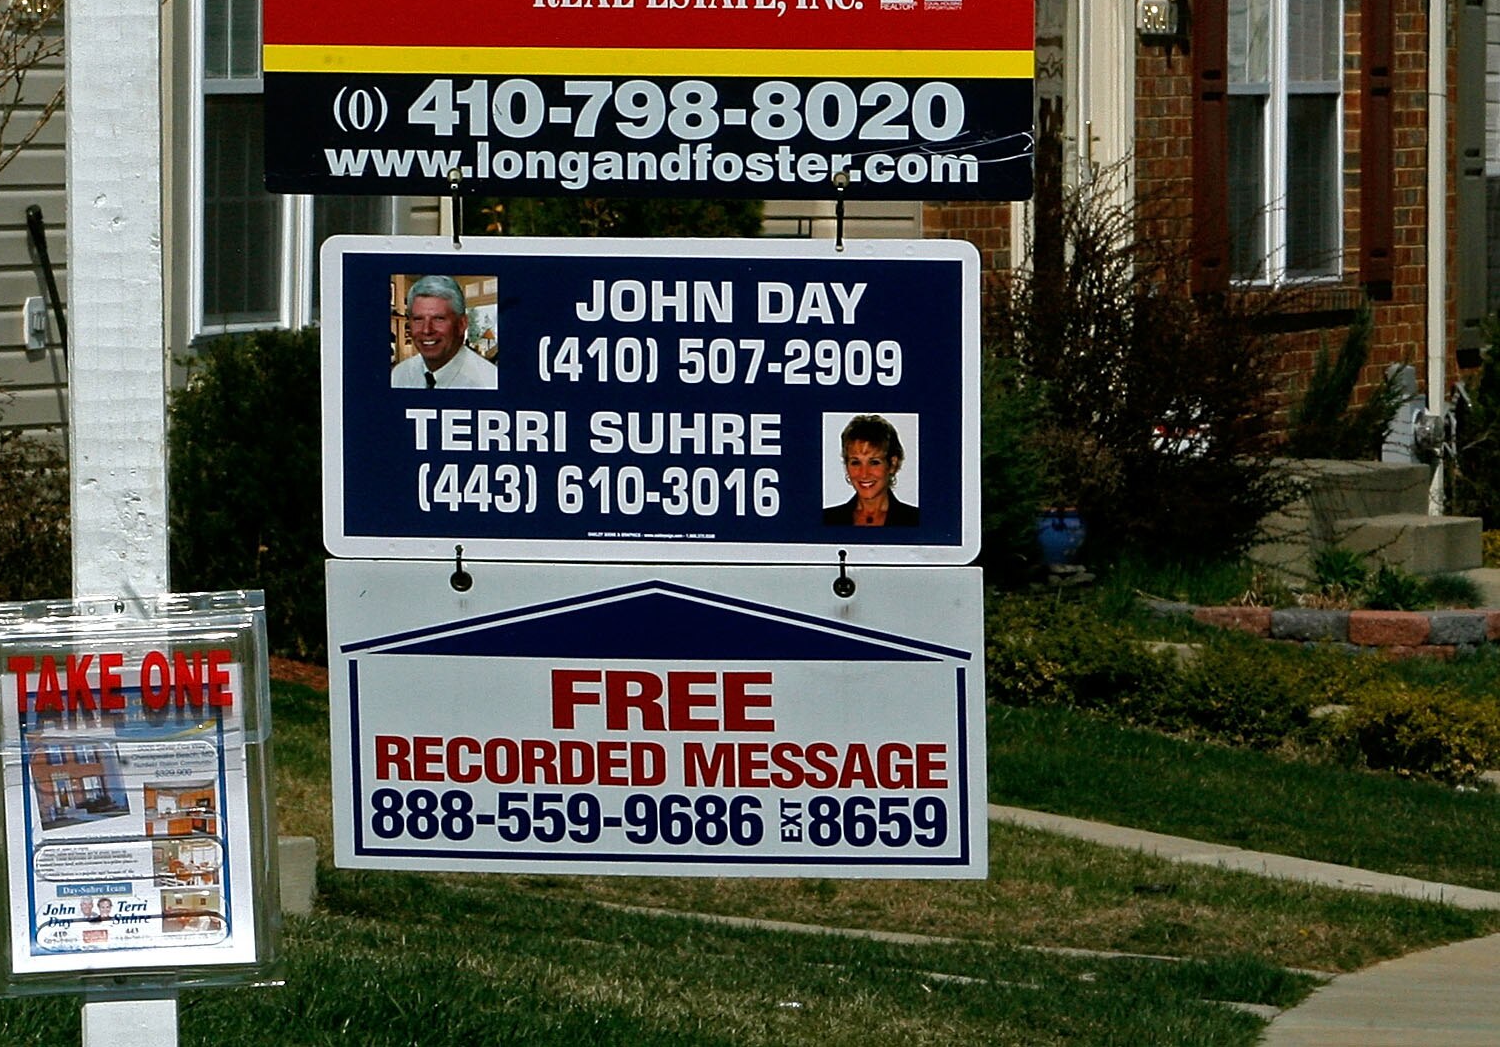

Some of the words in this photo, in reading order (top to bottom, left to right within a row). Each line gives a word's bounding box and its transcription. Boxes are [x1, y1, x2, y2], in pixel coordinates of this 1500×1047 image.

[407, 79, 965, 141] 410-798-8020
[324, 143, 979, 190] www.longandfoster.com
[576, 280, 733, 324] JOHN
[758, 282, 868, 325] DAY
[539, 336, 658, 383] (410)
[679, 339, 903, 387] 507-2909
[406, 408, 567, 453] TERRI
[590, 412, 782, 456] SUHRE
[419, 463, 538, 513] (443)
[558, 466, 780, 516] 610-3016
[8, 653, 125, 712] TAKE
[140, 650, 233, 708] ONE
[552, 669, 774, 732] FREE
[376, 735, 666, 786] RECORDED
[684, 742, 947, 789] MESSAGE
[371, 789, 764, 847] 888-559-9686
[780, 798, 803, 843] EXT
[808, 796, 947, 848] 8659
[43, 903, 76, 916] John
[118, 899, 149, 913] Terri
